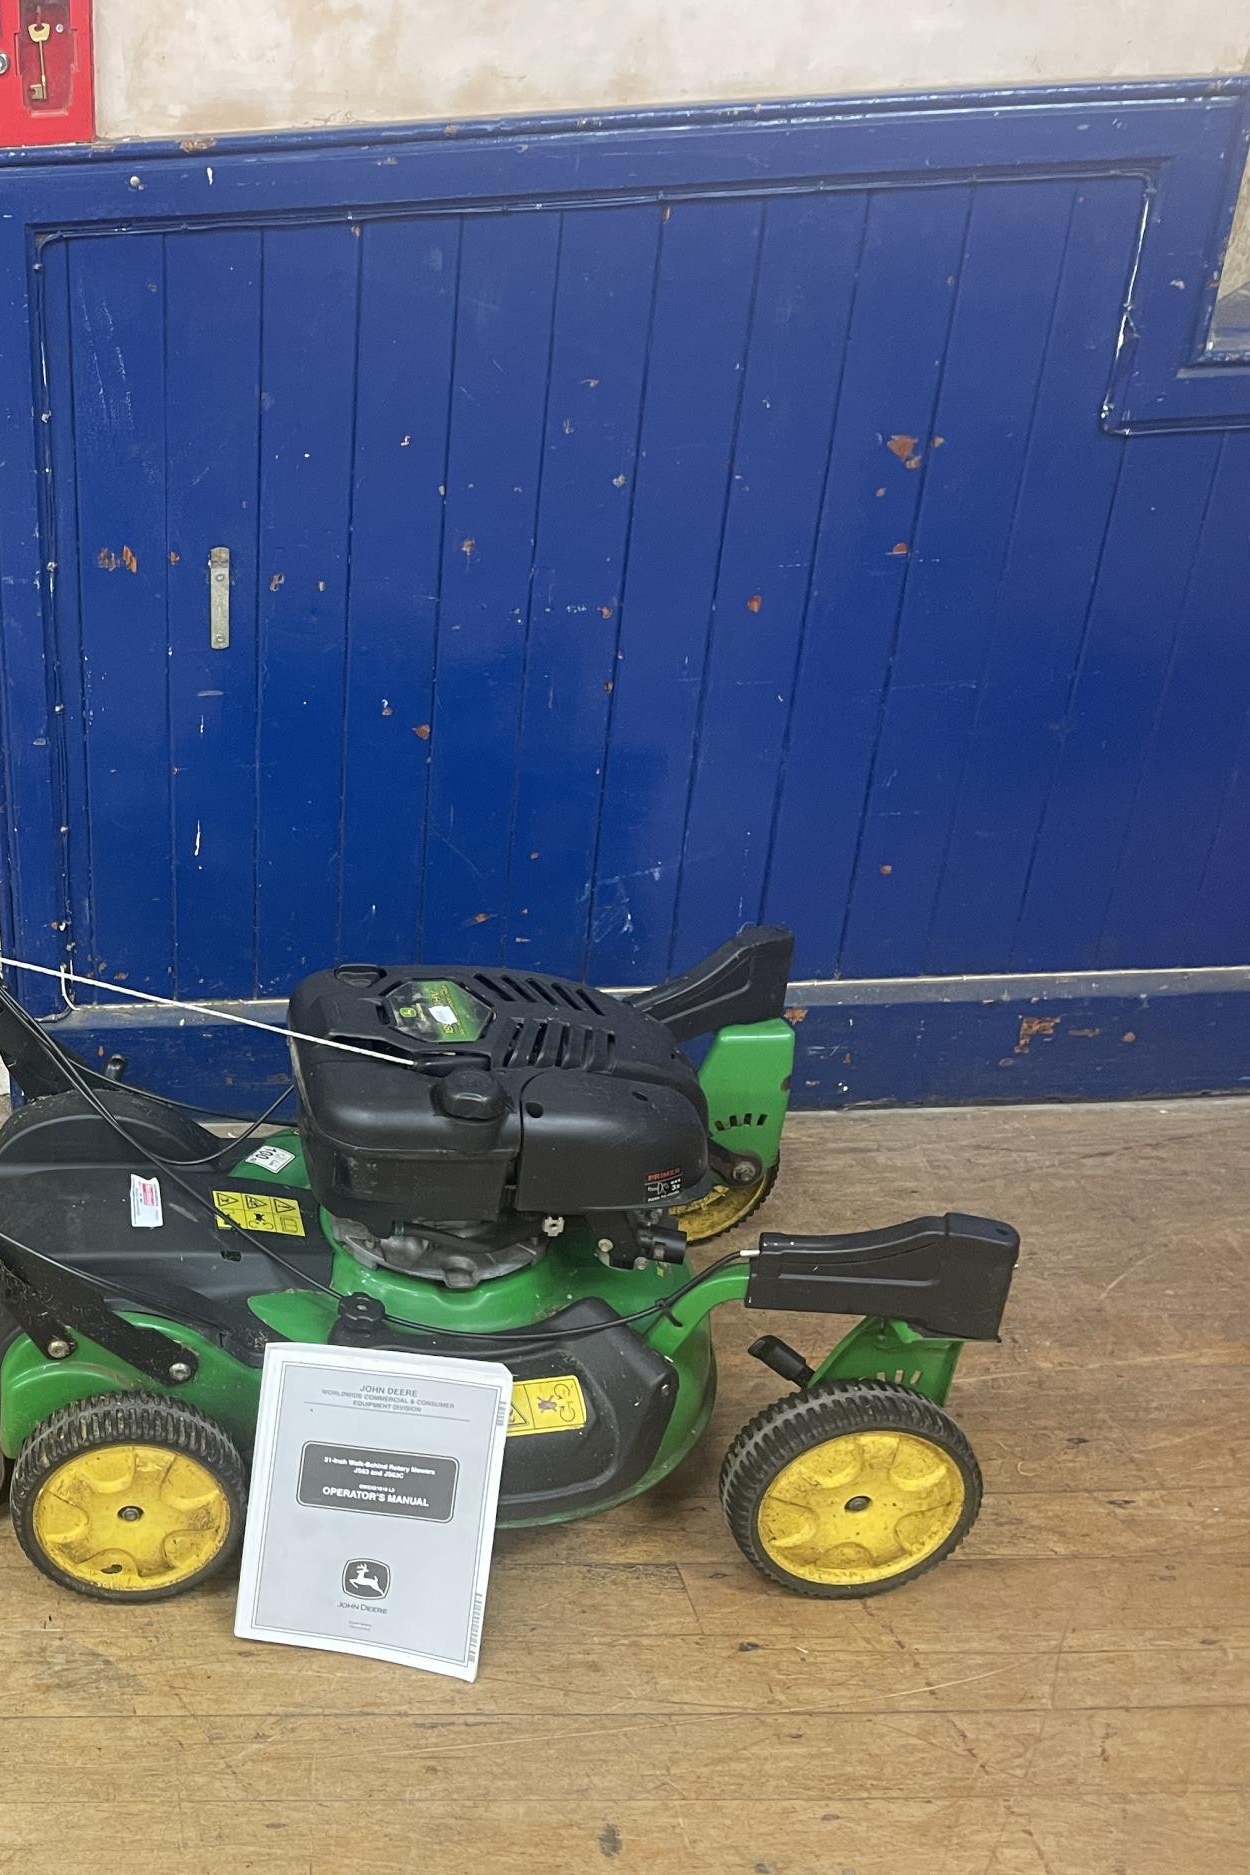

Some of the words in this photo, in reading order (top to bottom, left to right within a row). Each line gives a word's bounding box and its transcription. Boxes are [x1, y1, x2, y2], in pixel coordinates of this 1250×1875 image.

[647, 1168, 681, 1181] PRIMER
[322, 1388, 362, 1399] WORLDWIDE
[363, 1393, 408, 1404] COMMERCIAL
[416, 1399, 455, 1409] CONSUMER
[360, 1385, 385, 1394] JOHN
[387, 1387, 419, 1398] DEERE
[352, 1399, 391, 1409] EQUIPMENT
[392, 1403, 422, 1413] DIVISION
[348, 1458, 389, 1470] Walk-Behind
[389, 1464, 410, 1474] Rotary
[410, 1466, 436, 1476] Mowers
[322, 1486, 386, 1502] OPERATOR'S
[387, 1492, 430, 1507] MANUAL
[336, 1601, 359, 1610] JOHN
